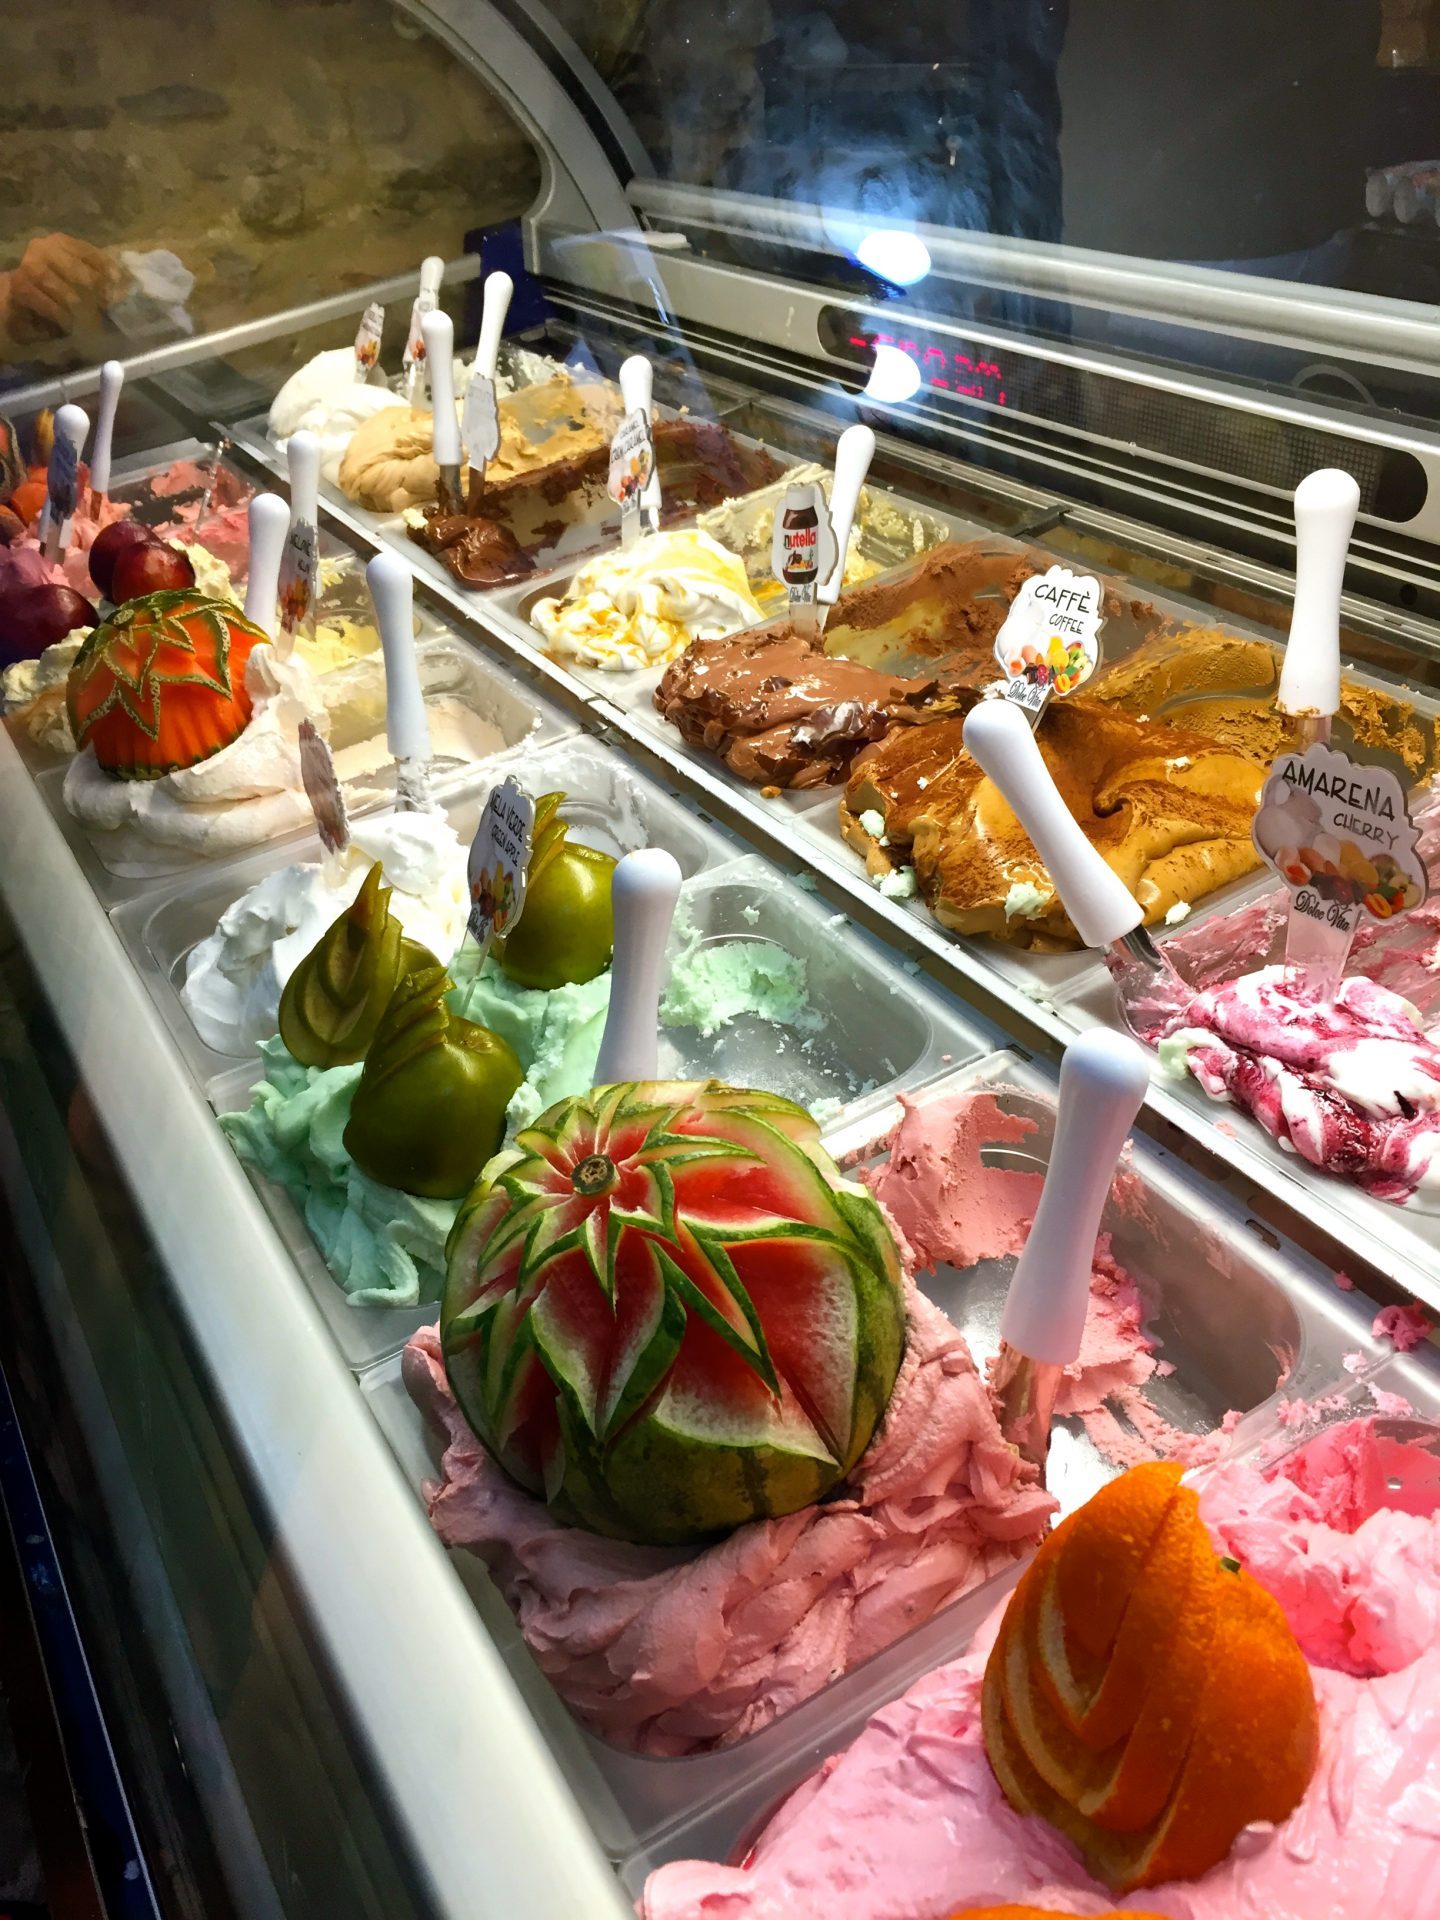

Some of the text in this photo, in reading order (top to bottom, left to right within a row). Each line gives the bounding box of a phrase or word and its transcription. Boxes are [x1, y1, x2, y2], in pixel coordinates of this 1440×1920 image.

[783, 528, 816, 549] nutella
[1034, 584, 1091, 614] CAFFÈ
[1048, 613, 1084, 635] COFFEE
[1281, 760, 1395, 822] AMARENA
[1333, 812, 1400, 850] CHERRY
[1294, 890, 1353, 932] Dolce Vita
